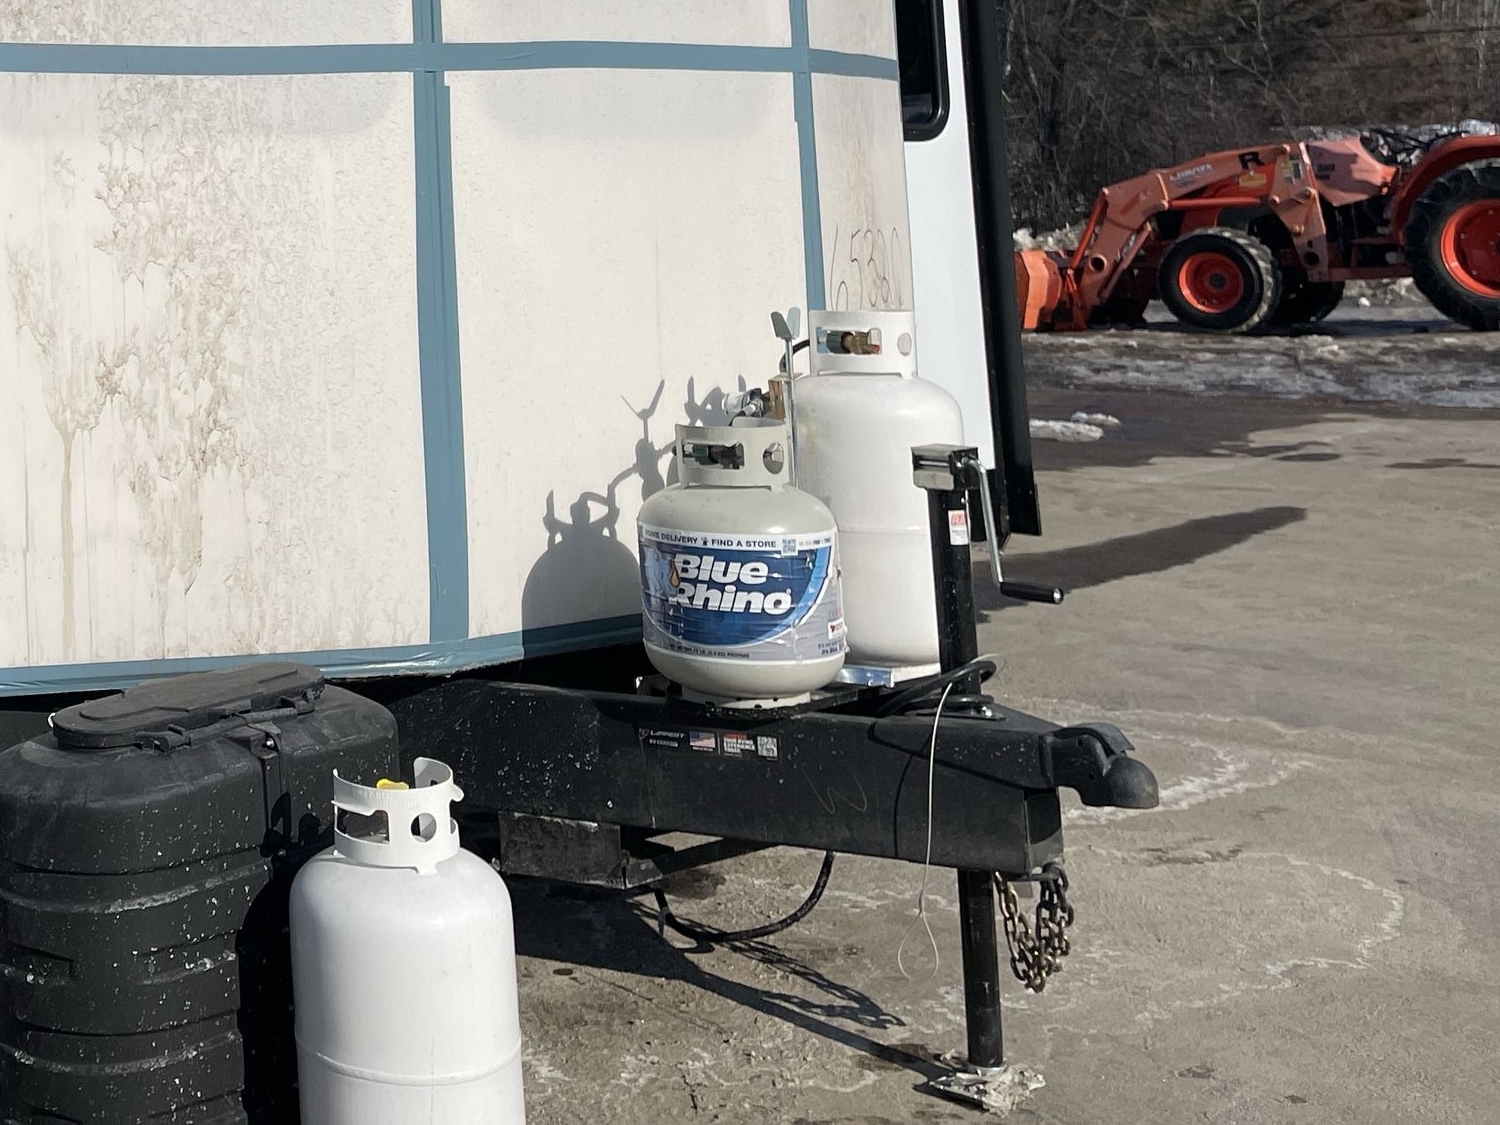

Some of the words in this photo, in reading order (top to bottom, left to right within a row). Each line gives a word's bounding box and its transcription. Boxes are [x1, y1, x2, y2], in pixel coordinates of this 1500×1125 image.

[661, 532, 698, 545] DELIVERY
[711, 538, 734, 547] FIND
[737, 539, 743, 548] A
[746, 539, 777, 549] STORE
[674, 553, 769, 585] Blue
[669, 582, 792, 616] Rhino
